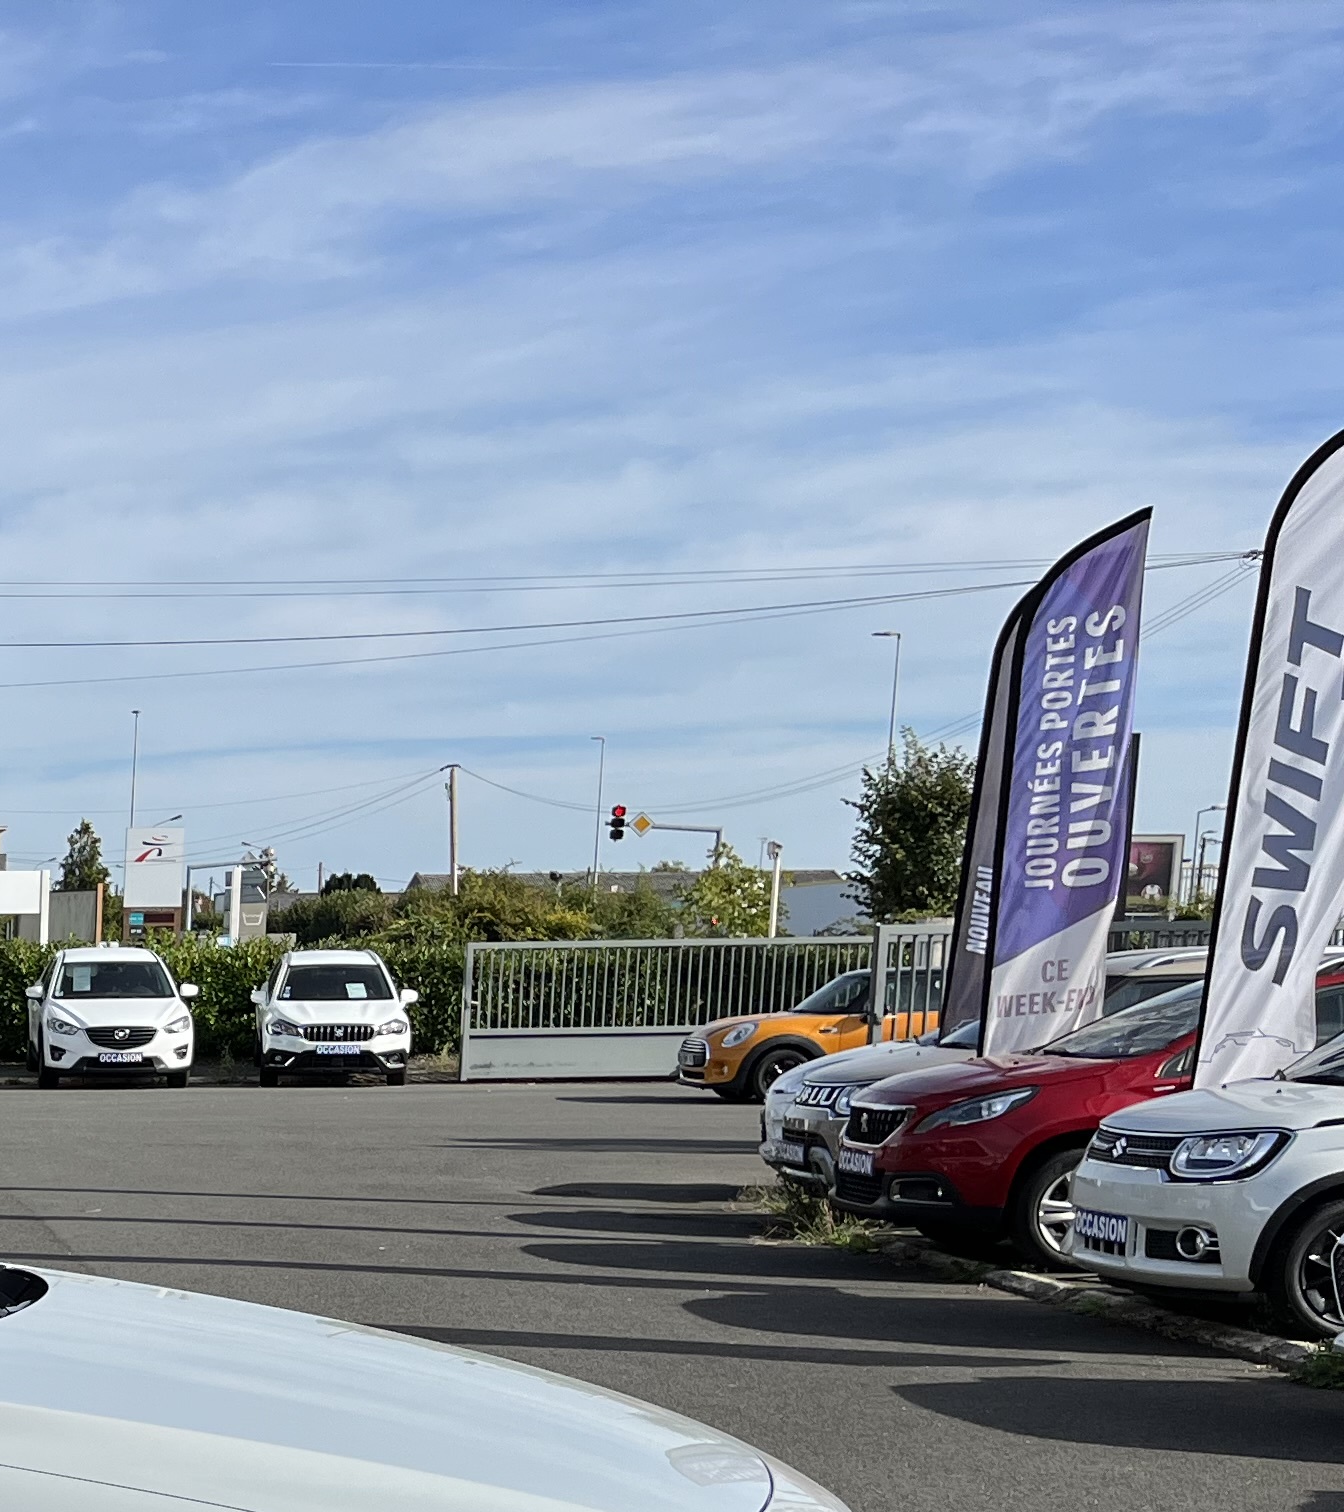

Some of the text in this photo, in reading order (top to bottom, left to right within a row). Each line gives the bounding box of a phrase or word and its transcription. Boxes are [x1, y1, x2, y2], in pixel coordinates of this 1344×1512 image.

[1024, 614, 1078, 891] JOURNÉES PORTES
[1061, 603, 1127, 889] OUVERTES
[1240, 585, 1344, 987] SWIFT
[965, 865, 993, 955] NOUVEAU
[1041, 959, 1070, 984] CE
[99, 1053, 143, 1063] OCCASION
[316, 1044, 360, 1055] OCCASION
[838, 1149, 874, 1176] OCCASION
[1075, 1210, 1128, 1244] OCCASION
